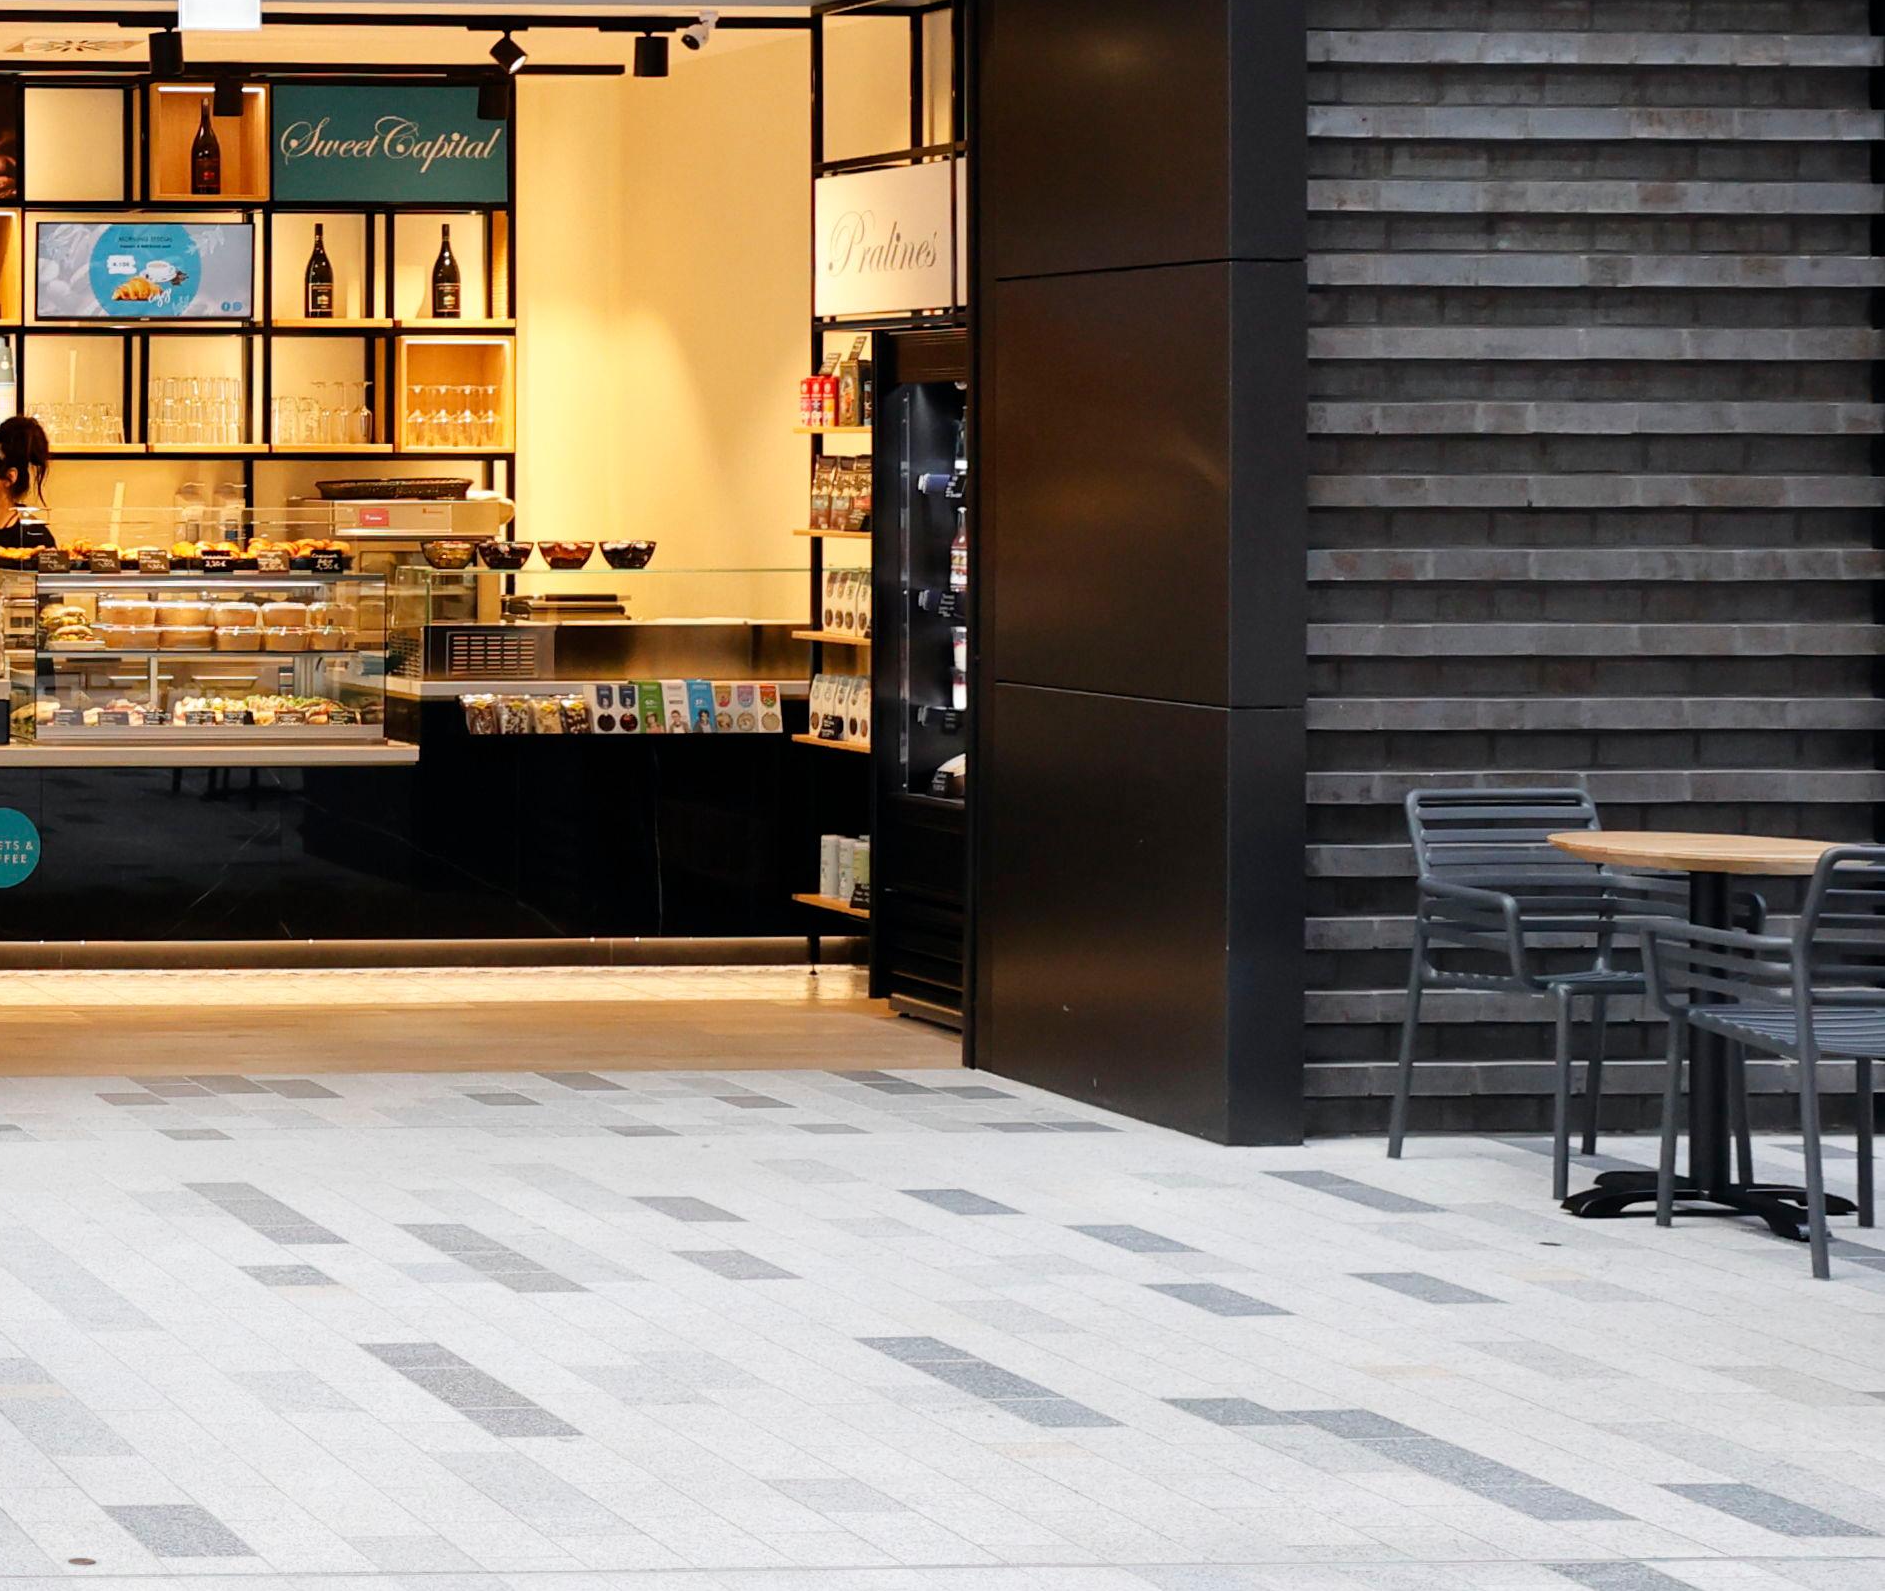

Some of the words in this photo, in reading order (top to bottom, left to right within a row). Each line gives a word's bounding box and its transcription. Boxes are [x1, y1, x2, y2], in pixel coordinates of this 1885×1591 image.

[280, 117, 379, 166] Sweet
[374, 115, 502, 174] Capital
[828, 209, 938, 278] Pralines
[25, 841, 34, 851] &
